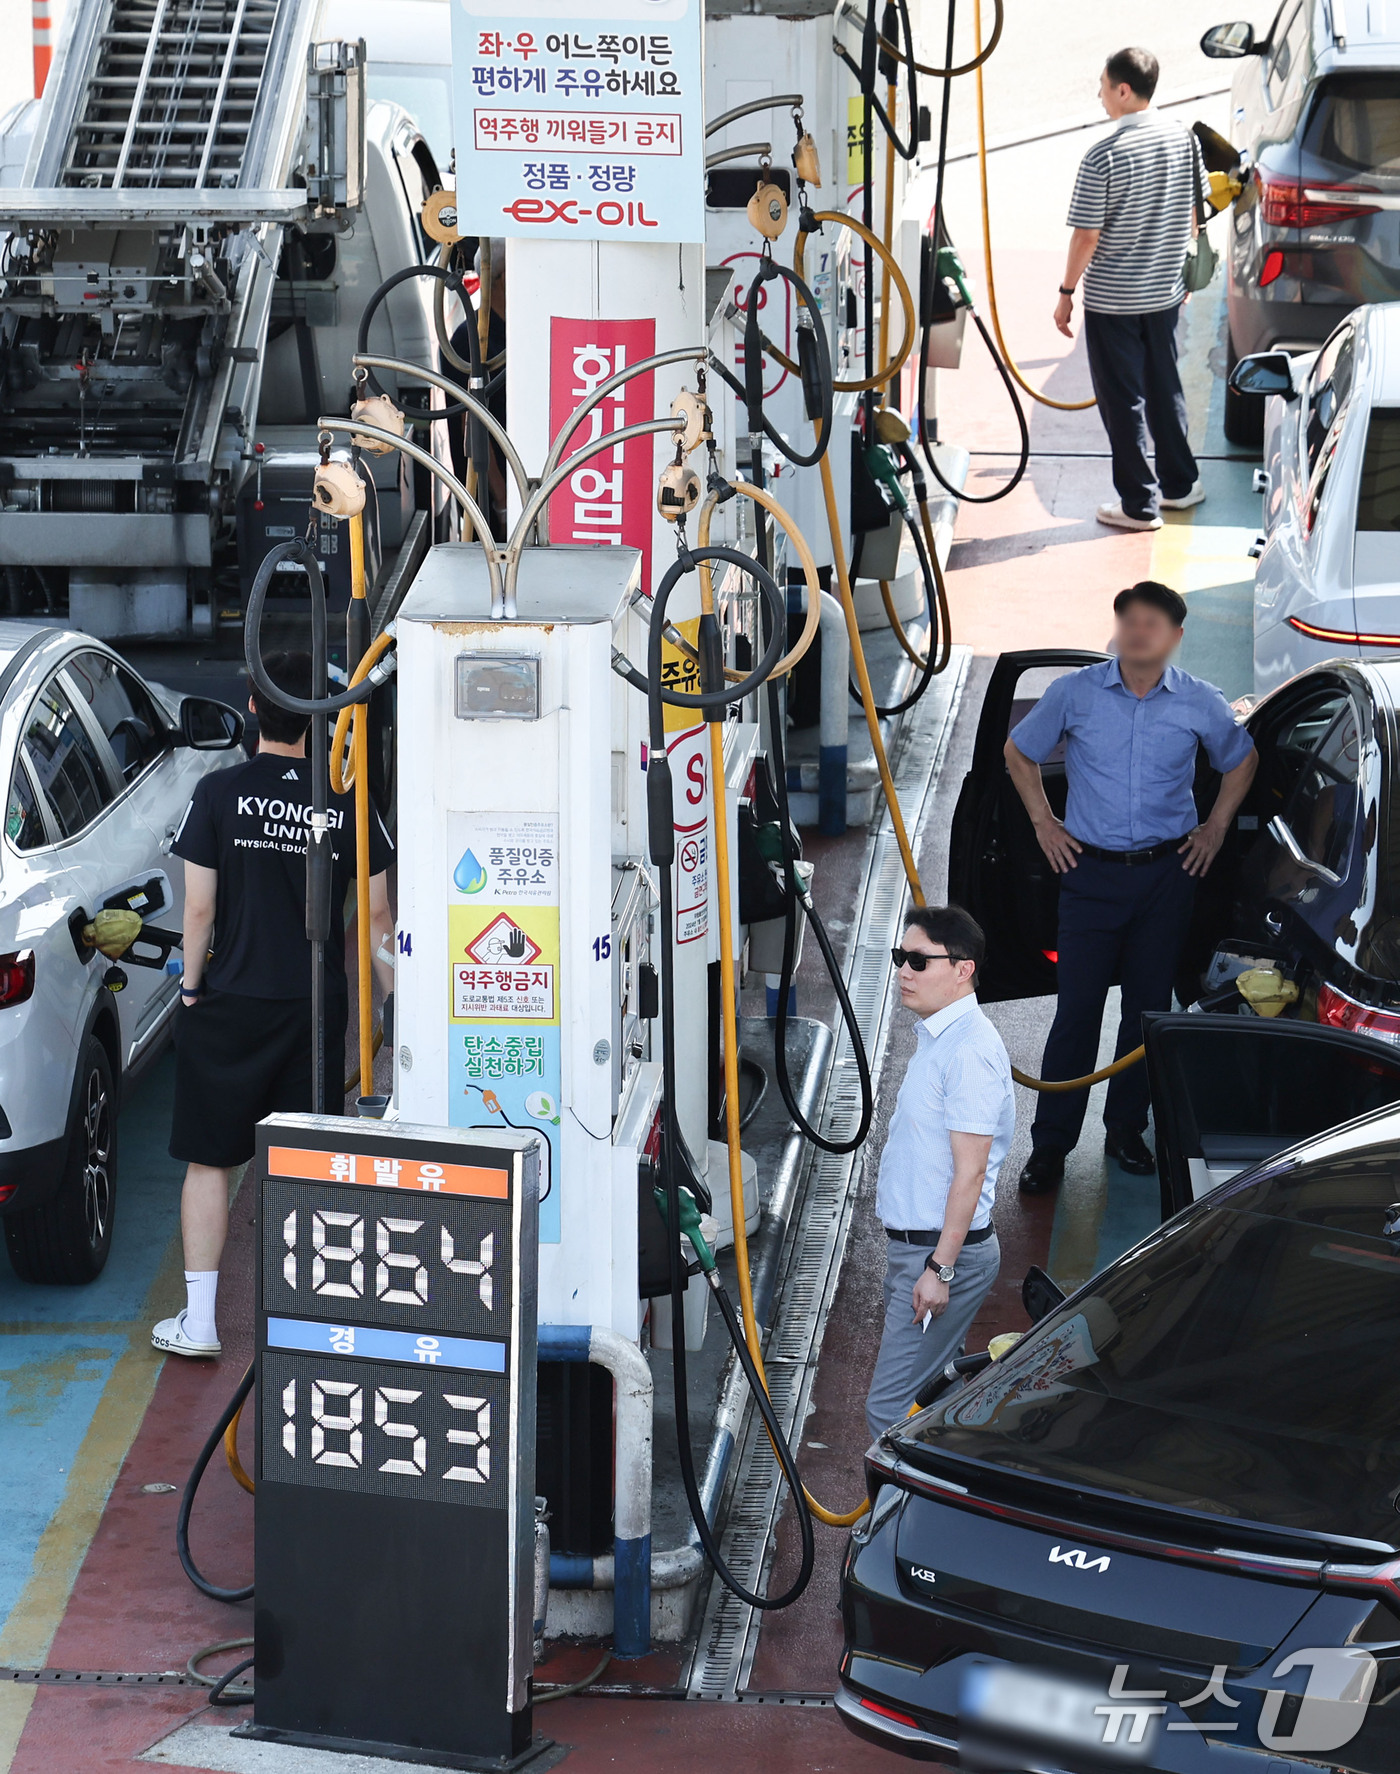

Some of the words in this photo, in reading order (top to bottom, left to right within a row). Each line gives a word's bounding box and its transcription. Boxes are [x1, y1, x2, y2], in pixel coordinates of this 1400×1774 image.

[478, 32, 538, 61] 좌·우
[545, 33, 672, 66] 어느쪽이든
[472, 66, 546, 96] 편하게
[554, 68, 682, 97] 주유하세요
[479, 117, 539, 143] 역주행
[546, 118, 628, 145] 끼워들기
[634, 121, 675, 146] 금지
[820, 253, 829, 272] 7
[660, 658, 701, 692] 주유
[234, 838, 280, 851] PHYSICAL
[281, 843, 339, 861] EDUCN
[489, 847, 554, 867] 품질인증
[497, 868, 546, 886] 주유소
[397, 930, 413, 957] 14
[592, 934, 611, 961] 15
[459, 970, 548, 992] 역주행금지
[461, 1003, 487, 1012] 지시위반
[489, 1004, 509, 1012] 과태료
[462, 995, 495, 1004] 도로교통법
[516, 995, 529, 1004] 신호
[531, 996, 545, 1005] 또는
[463, 1035, 543, 1056] 탄소중립
[463, 1057, 544, 1078] 실천하기
[283, 1209, 494, 1312] 1864
[283, 1378, 491, 1484] 1853
[911, 1566, 936, 1583] K8
